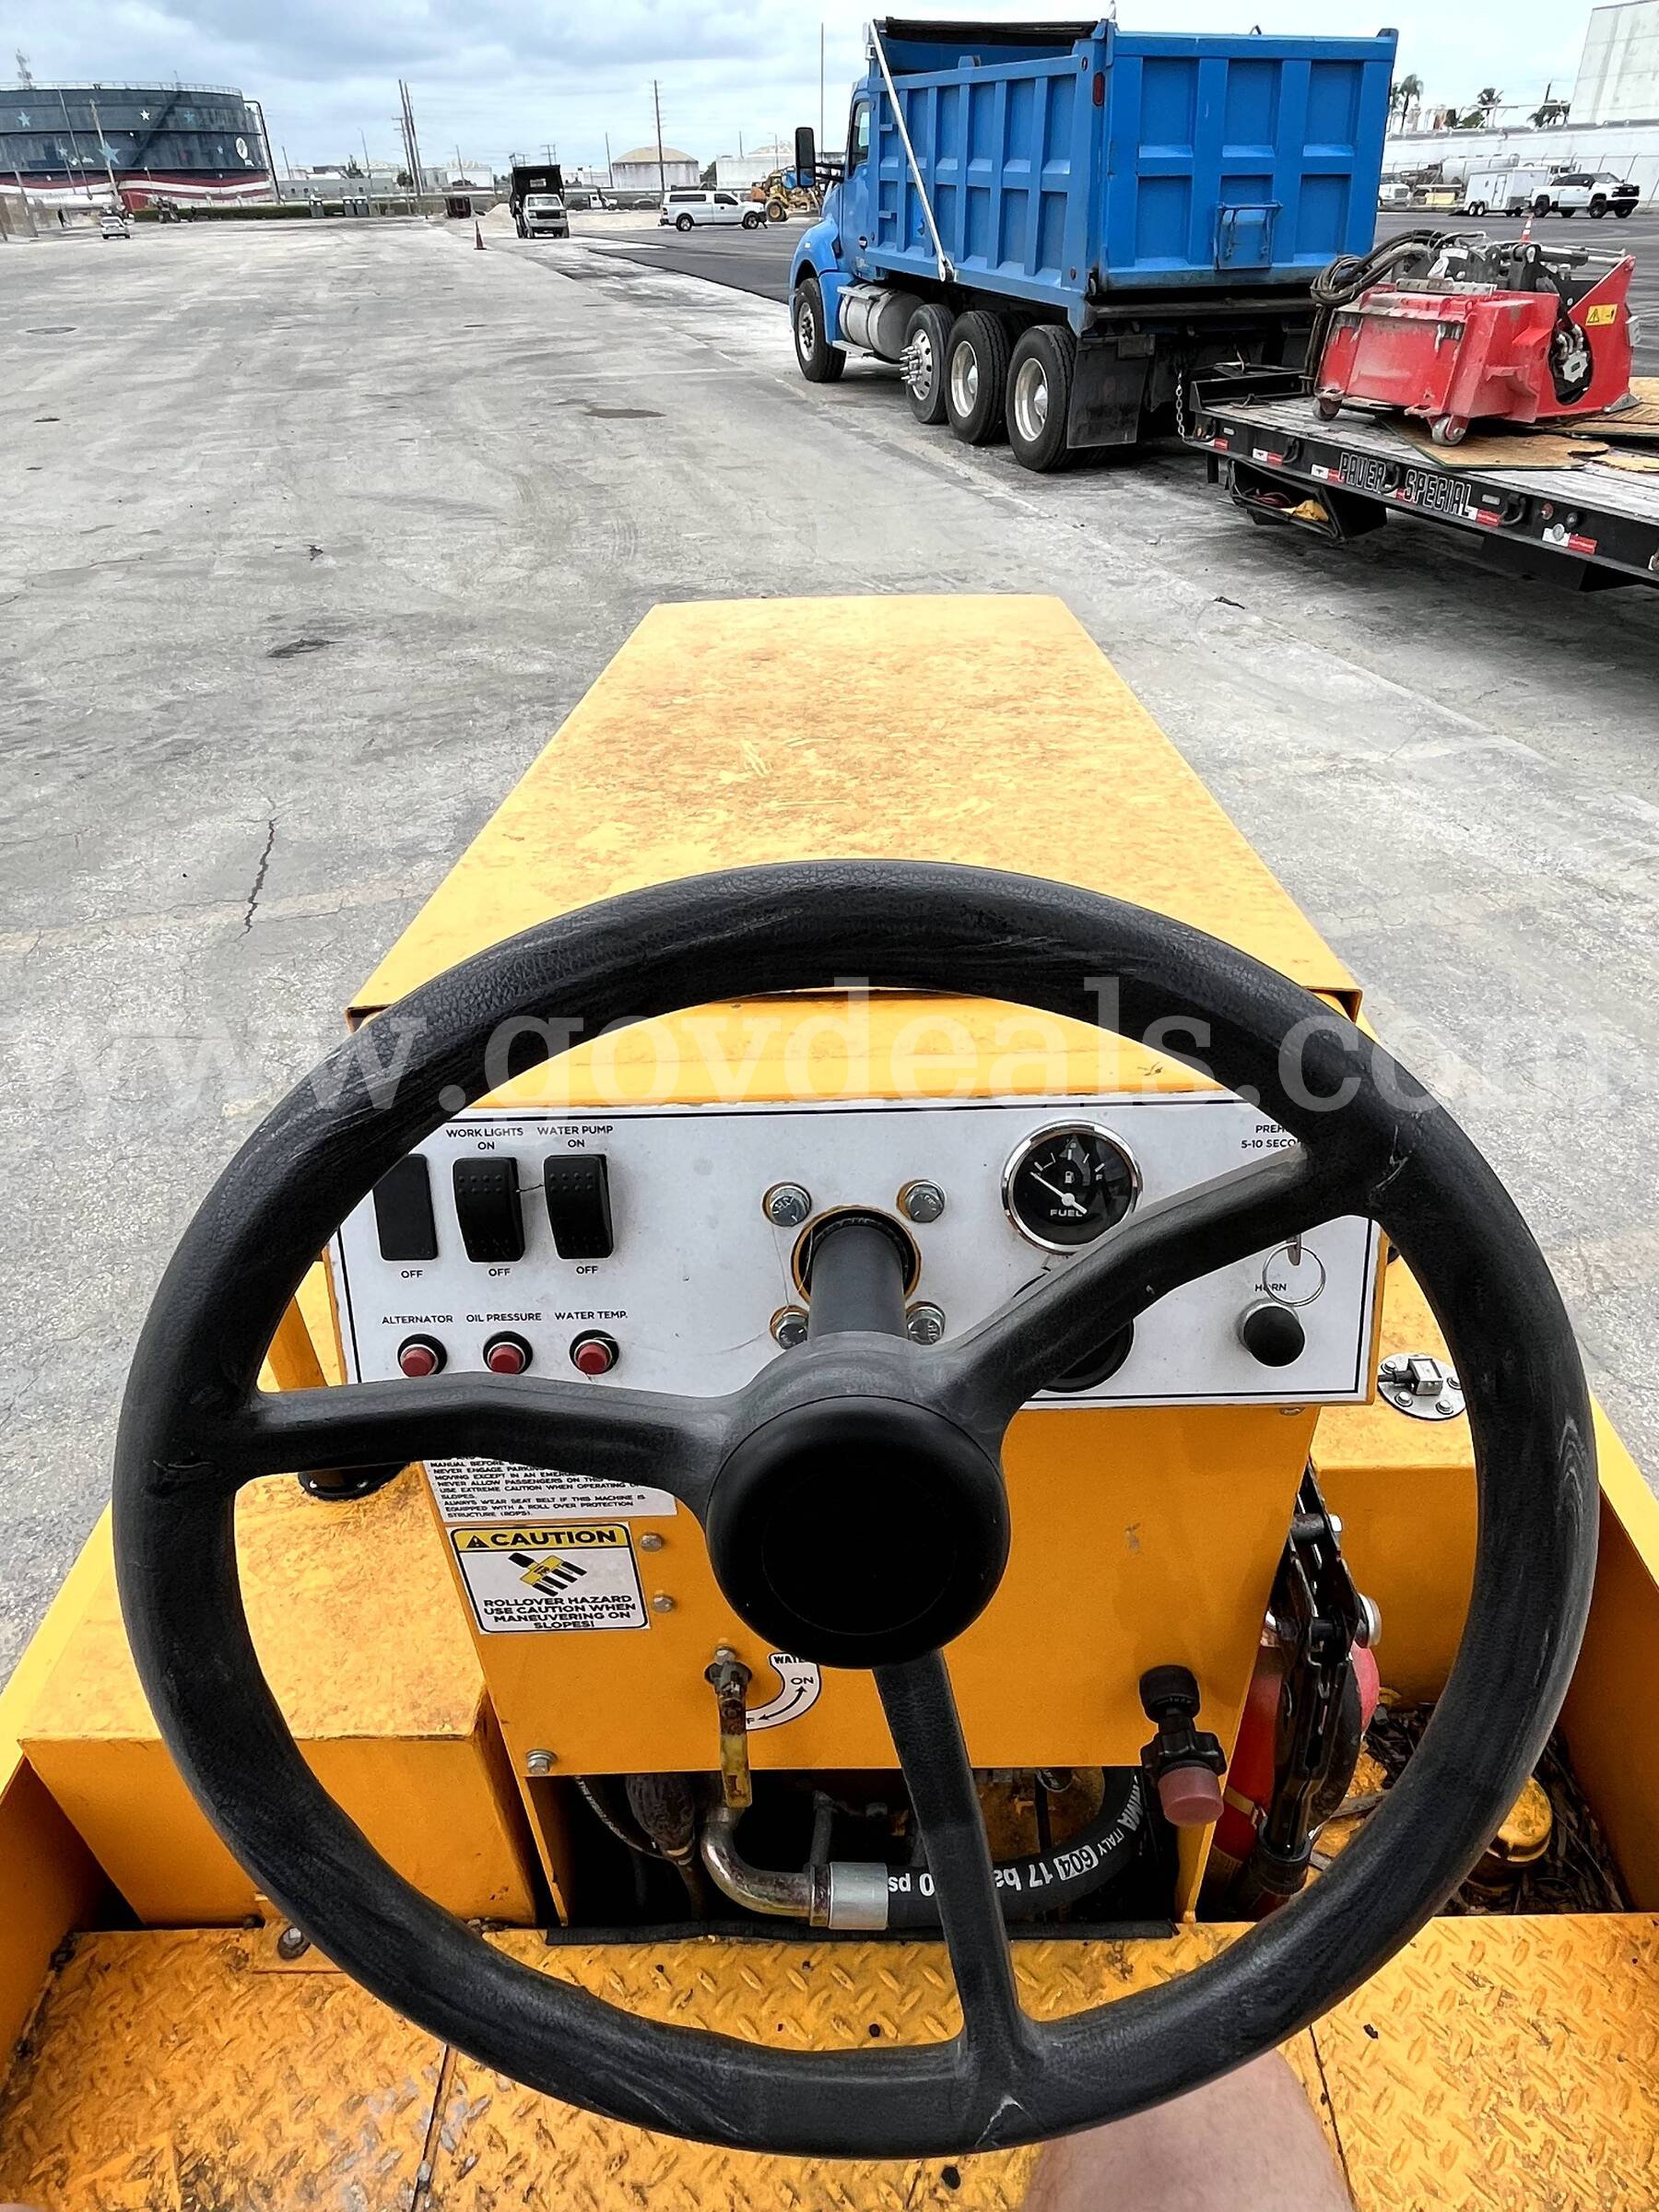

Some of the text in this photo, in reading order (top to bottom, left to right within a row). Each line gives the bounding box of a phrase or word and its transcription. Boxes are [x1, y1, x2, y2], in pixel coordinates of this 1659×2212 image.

[1404, 469, 1472, 517] SPECIAL
[446, 1126, 524, 1139] WORK LIGHTS
[537, 1124, 614, 1135] WATER PUMP
[1255, 1124, 1286, 1134] PREH
[477, 1141, 495, 1150] ON
[567, 1138, 585, 1148] ON
[1241, 1138, 1297, 1148] 5-10 SECO
[1050, 1208, 1083, 1218] FUEL
[401, 1269, 423, 1279] OFF
[488, 1267, 511, 1277] OFF
[576, 1265, 598, 1276] OFF
[1254, 1282, 1287, 1292] HORN
[382, 1314, 453, 1324] ALTERNATOR
[465, 1312, 542, 1323] OIL PRESSURE
[555, 1311, 629, 1321] WATER TEMP.
[490, 1530, 617, 1546] CAUTION
[484, 1595, 632, 1607] ROLLOVER HAZARD
[484, 1603, 637, 1615] USE CAUTION WHEN
[494, 1613, 605, 1622] MANEUVERING
[534, 1620, 595, 1630] SLOPES!
[790, 1677, 815, 1686] ON
[1097, 1828, 1125, 1856] ITALY
[1057, 1848, 1095, 1879] 604
[993, 1867, 1022, 1891] ba
[1028, 1862, 1053, 1888] 17
[888, 1873, 912, 1892] ps
